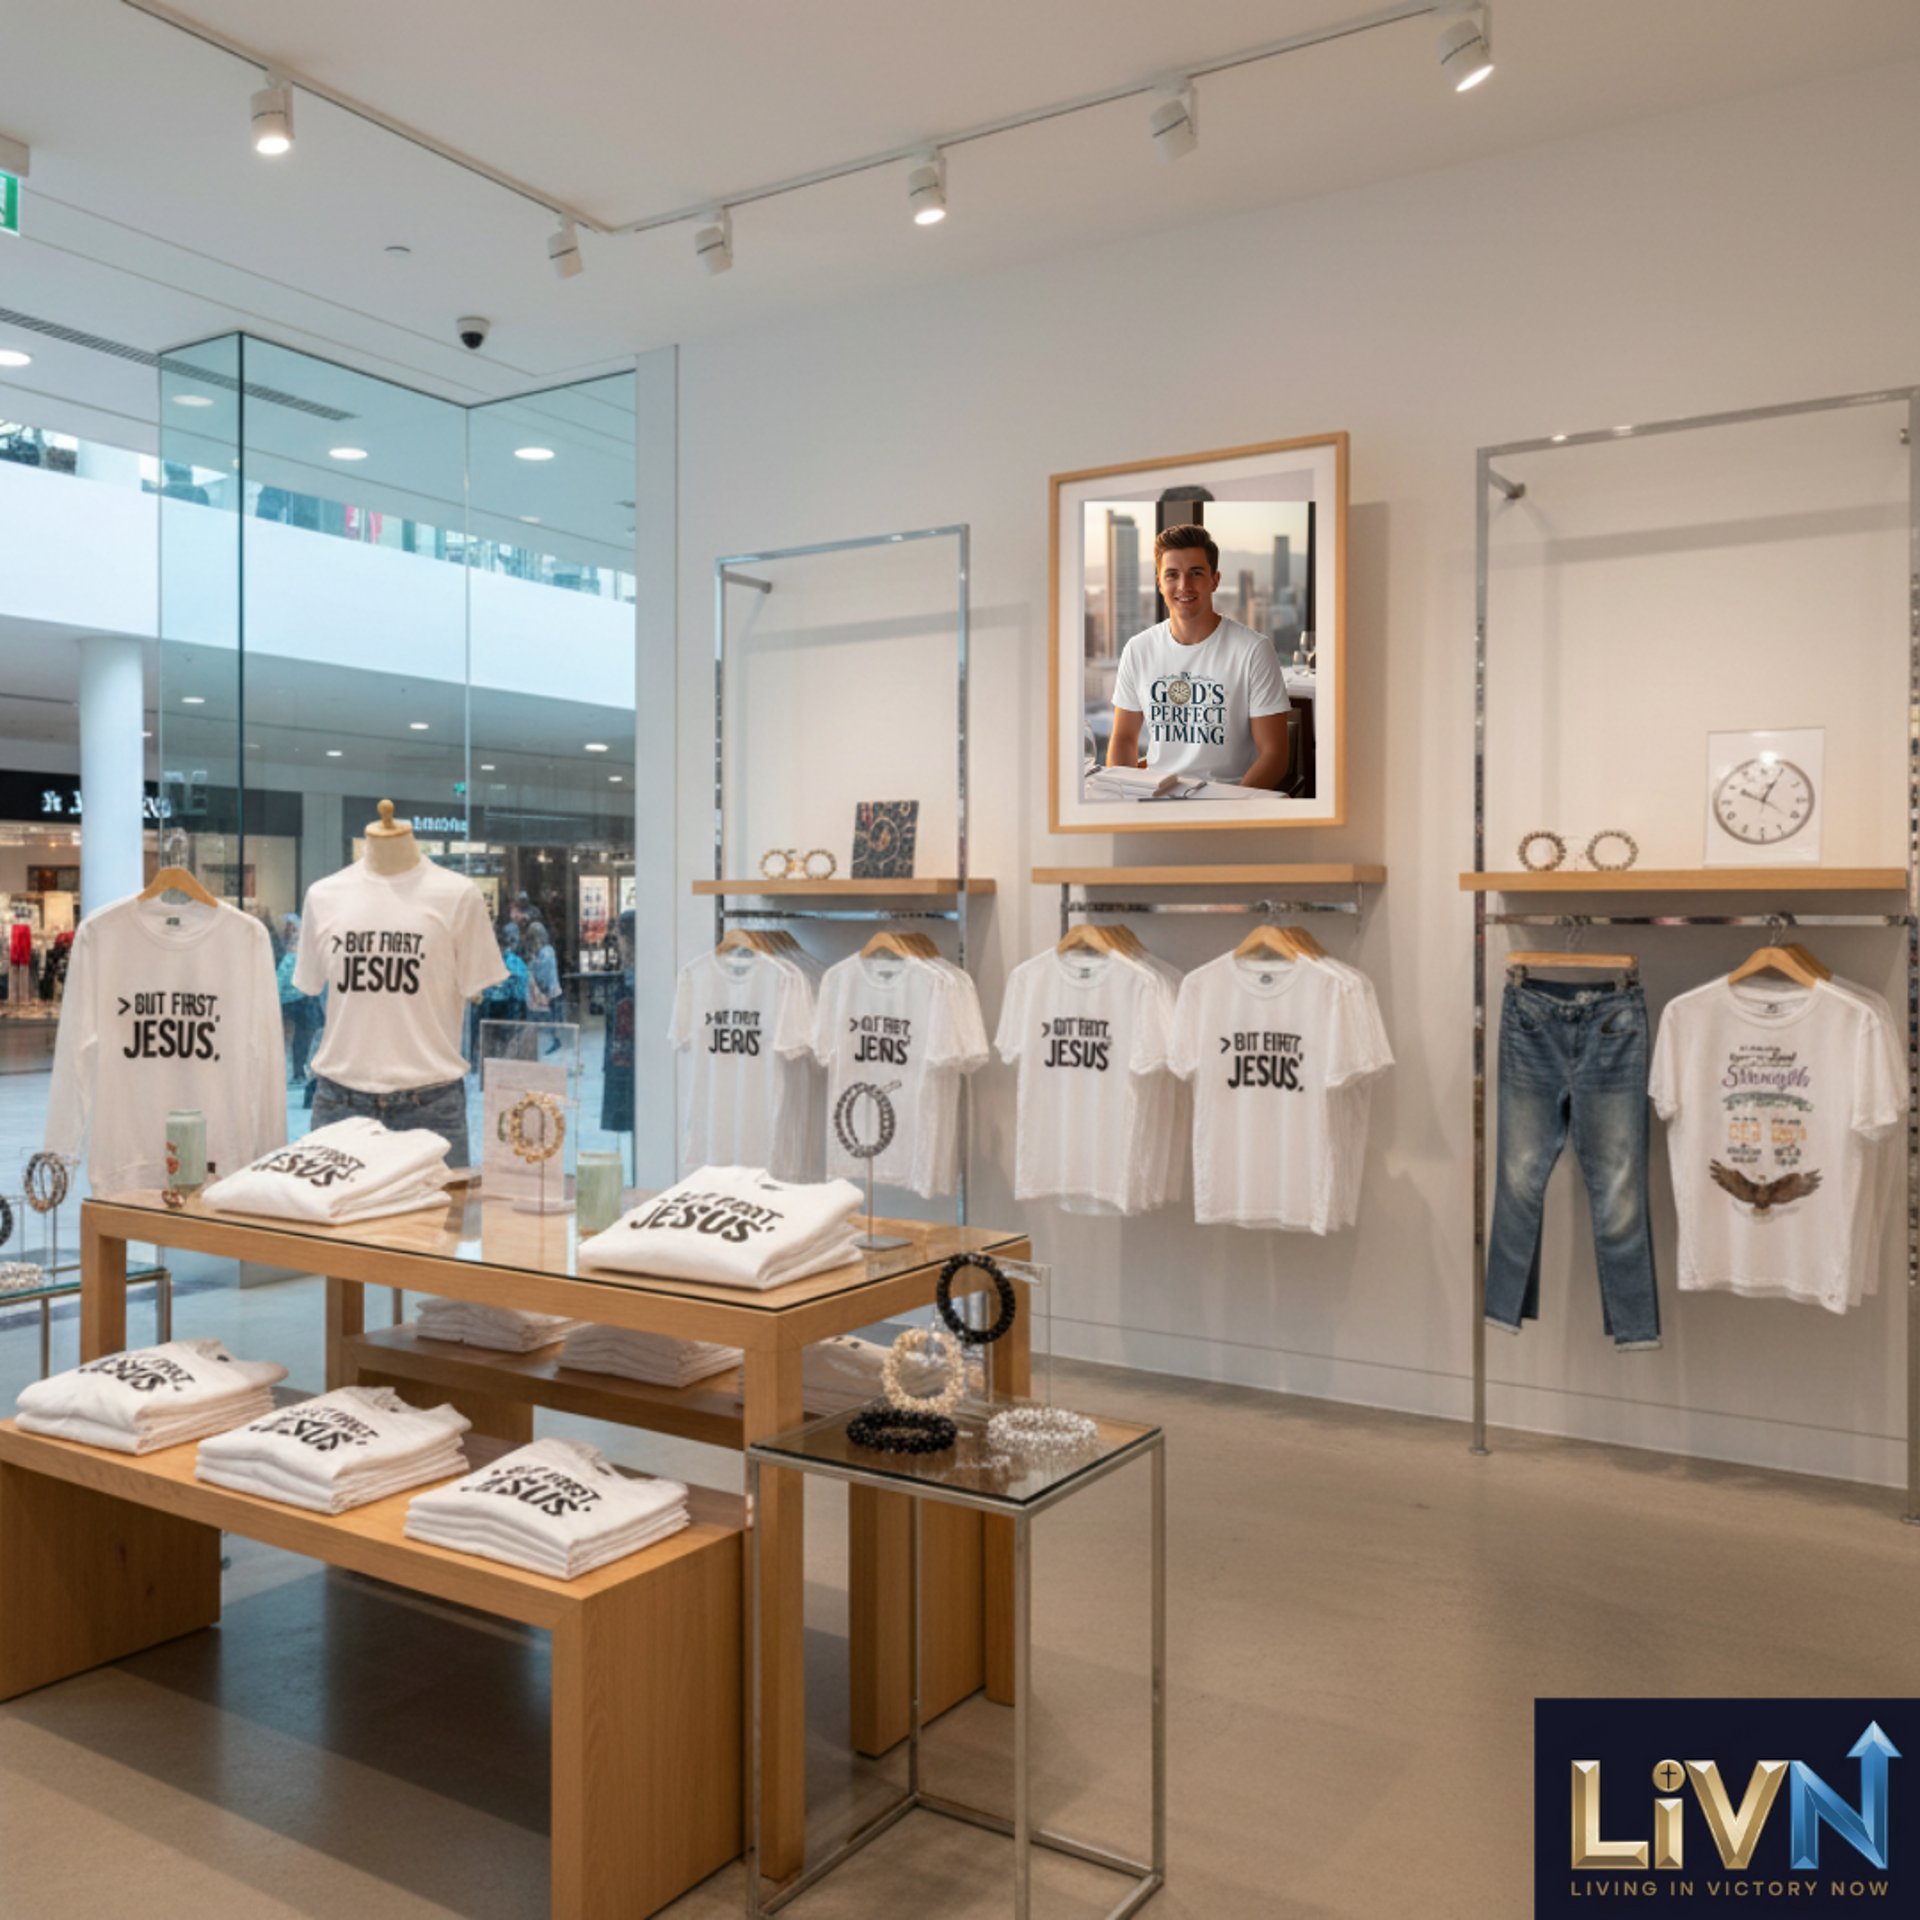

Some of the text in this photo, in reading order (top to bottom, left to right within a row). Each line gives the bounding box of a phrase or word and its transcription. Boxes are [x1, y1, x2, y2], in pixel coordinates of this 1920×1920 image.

[1150, 705, 1227, 724] PERFECT
[1152, 724, 1224, 745] TIMING
[337, 956, 420, 995] JESUS
[1044, 1039, 1109, 1072] JESUS
